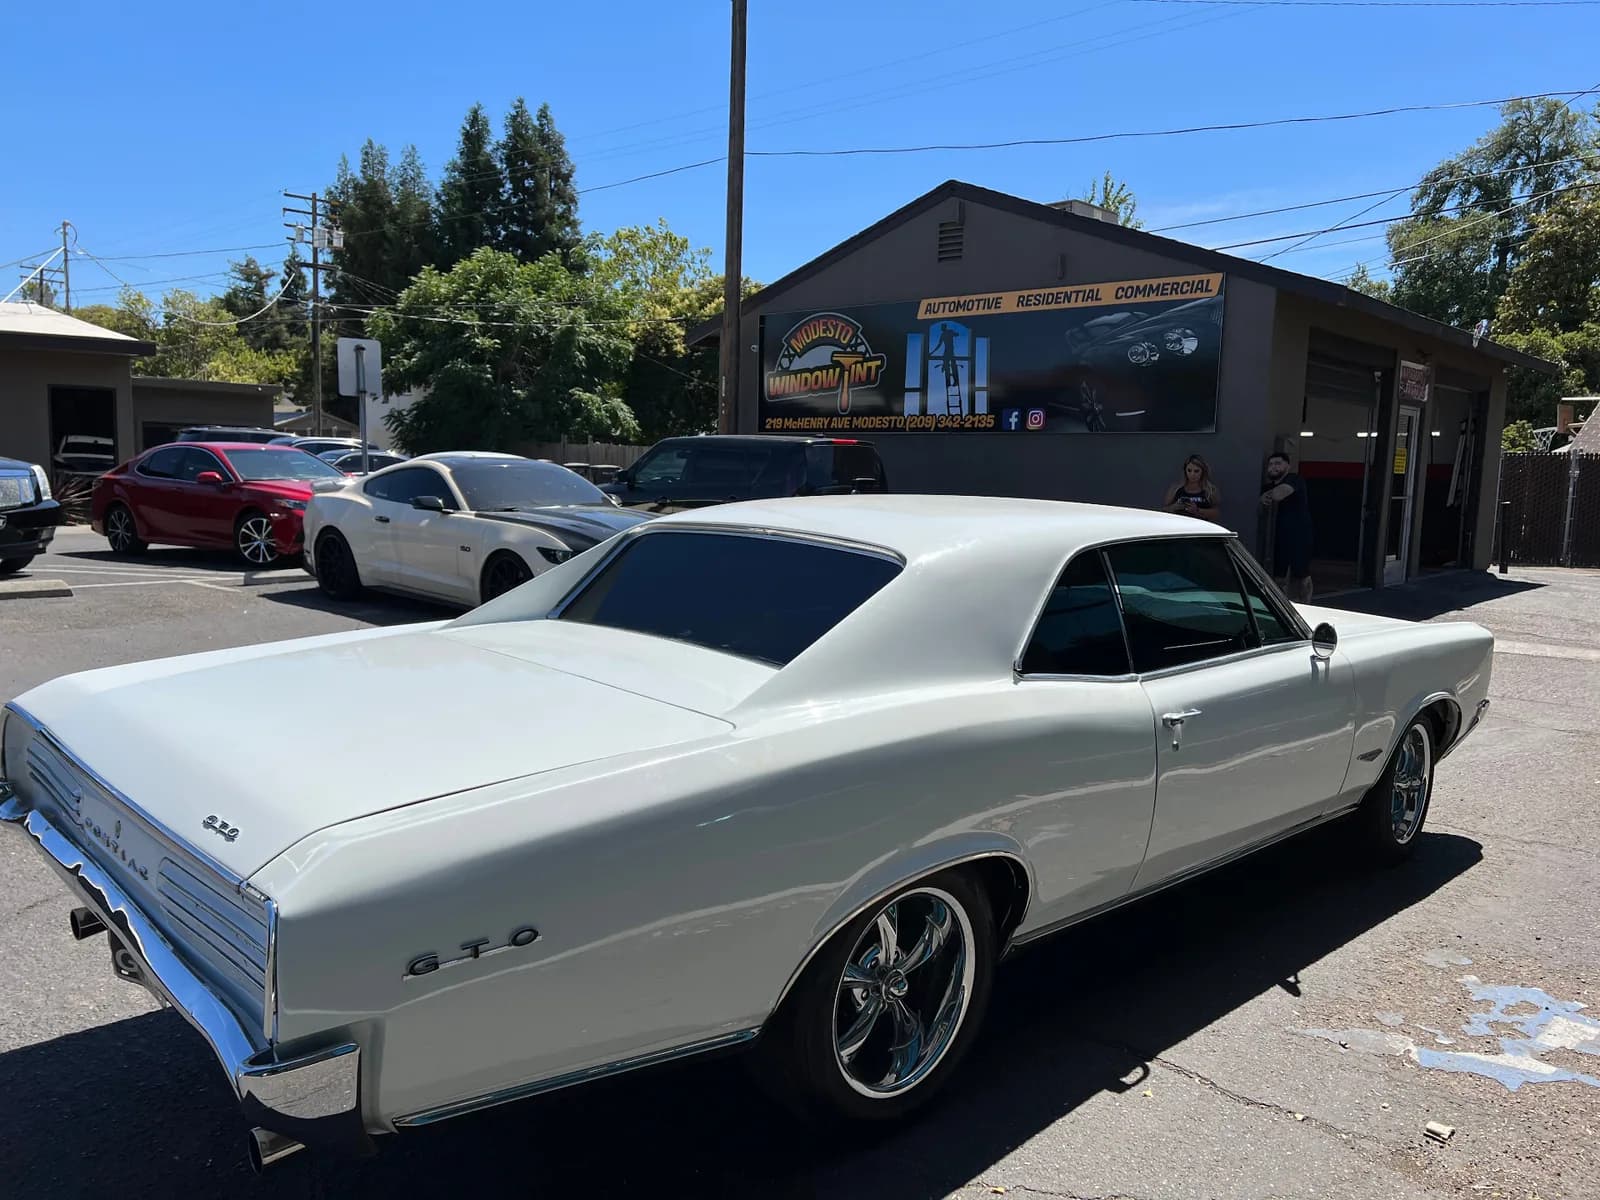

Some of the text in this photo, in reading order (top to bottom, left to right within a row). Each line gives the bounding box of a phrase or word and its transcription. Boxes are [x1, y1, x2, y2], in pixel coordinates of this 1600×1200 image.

[924, 278, 1214, 315] AUTOMOTIVE RESIDENTIAL COMMERCIAL
[790, 319, 853, 353] MODESTO
[769, 367, 841, 397] WINDOW
[765, 417, 782, 429] 219
[783, 417, 830, 429] McHENRY
[830, 416, 851, 429] AVE
[906, 415, 936, 431] (209)
[937, 415, 995, 428] 342-2135
[202, 814, 240, 842] GTO
[403, 927, 542, 979] GTO
